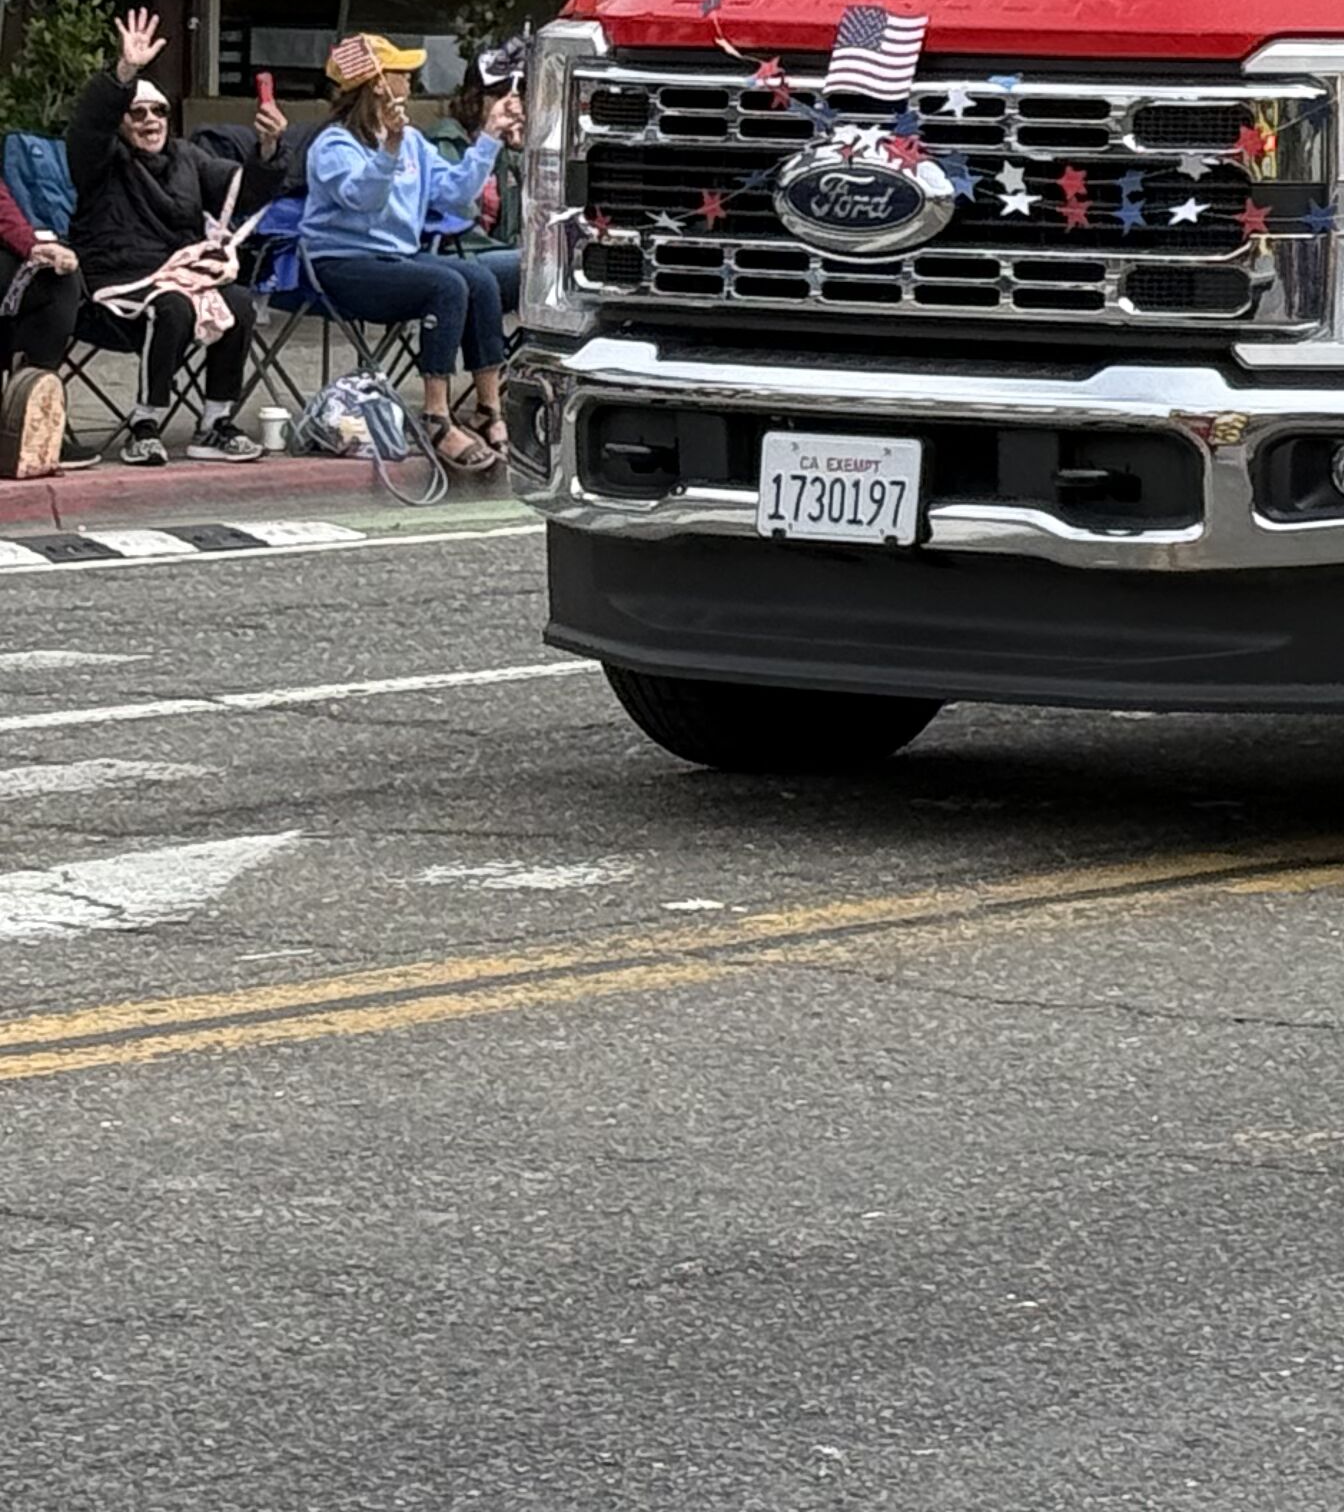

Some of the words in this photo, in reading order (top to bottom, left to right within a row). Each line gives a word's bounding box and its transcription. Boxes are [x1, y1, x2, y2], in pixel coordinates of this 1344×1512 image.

[810, 172, 894, 219] Ford
[800, 456, 819, 470] CA
[826, 457, 882, 473] EXEMPT
[767, 473, 907, 528] 1730197
